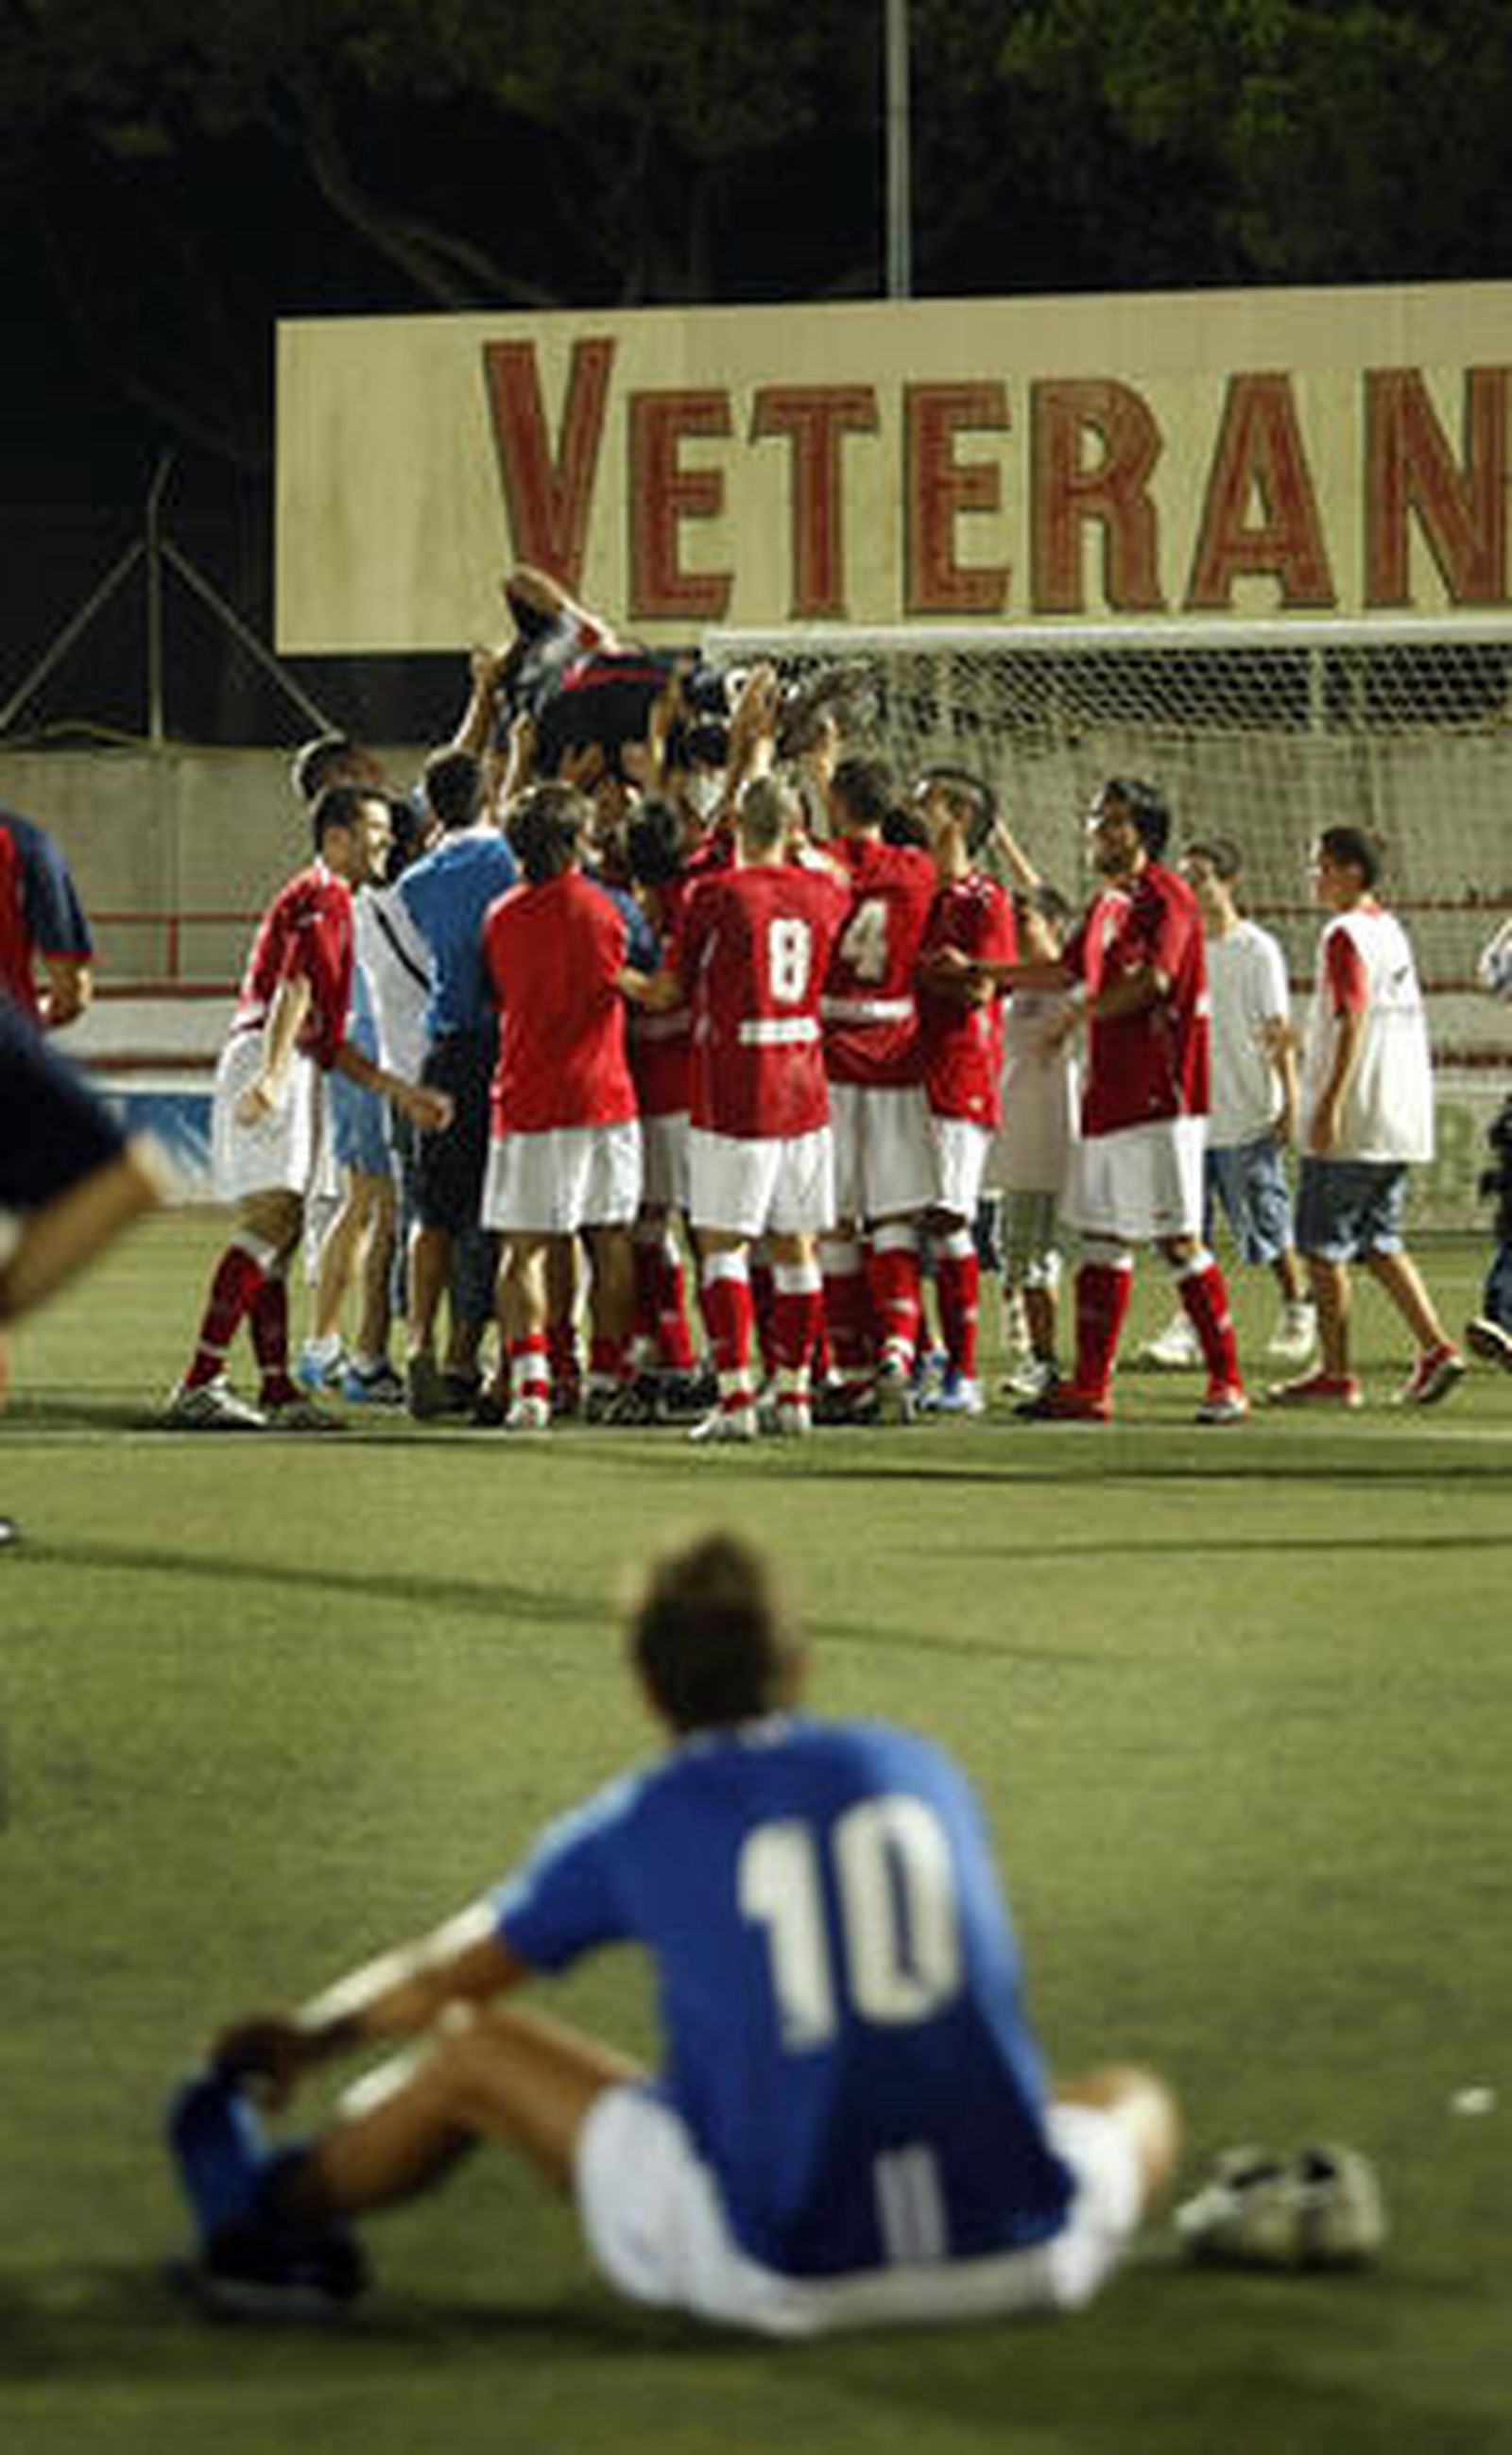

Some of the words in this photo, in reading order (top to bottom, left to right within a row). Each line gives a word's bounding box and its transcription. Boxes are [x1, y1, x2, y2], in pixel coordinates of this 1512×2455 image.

[768, 918, 812, 1004] 8
[841, 899, 886, 980] 4
[739, 1794, 960, 2052] 10
